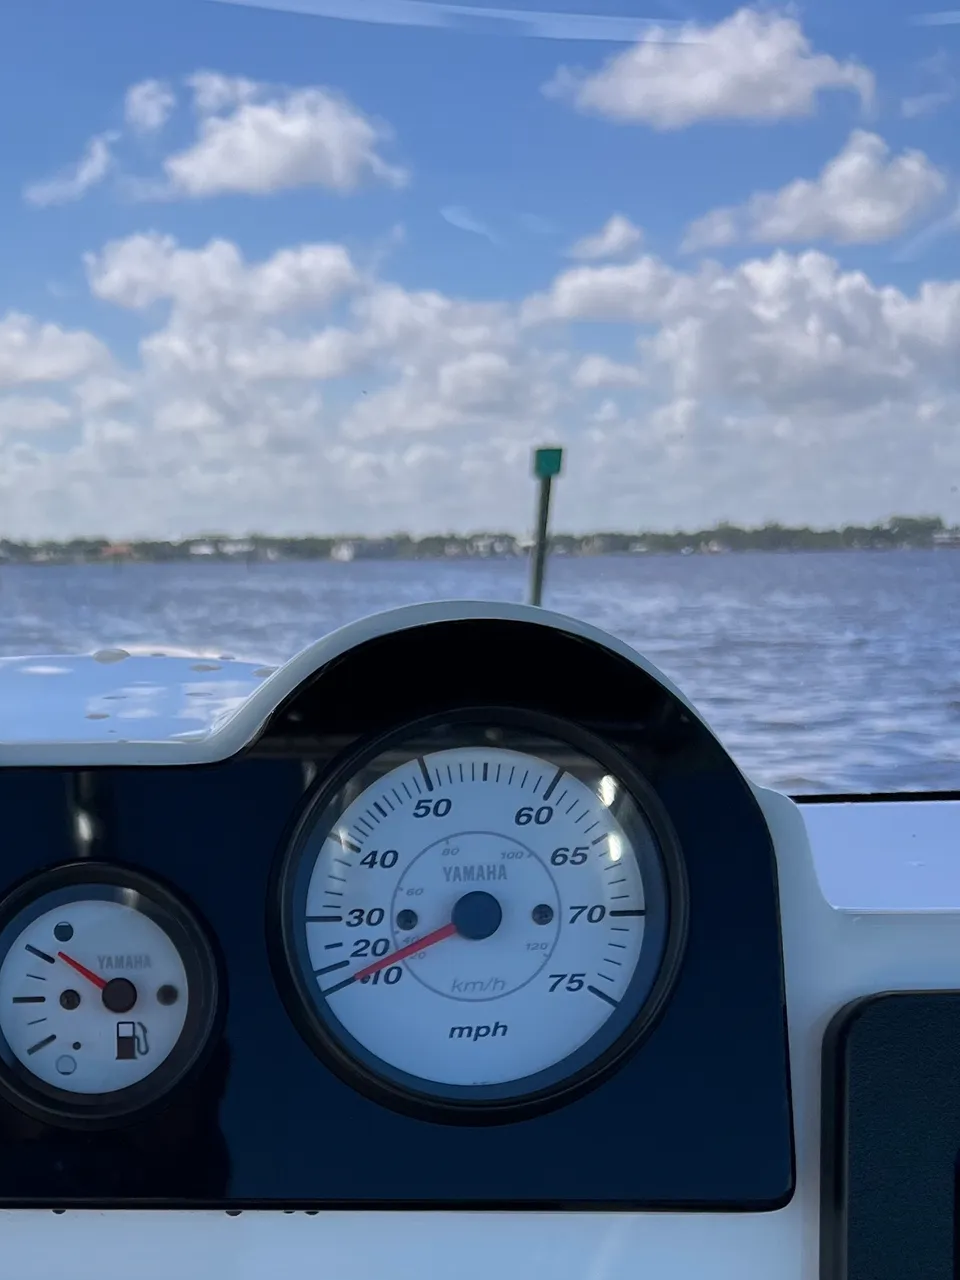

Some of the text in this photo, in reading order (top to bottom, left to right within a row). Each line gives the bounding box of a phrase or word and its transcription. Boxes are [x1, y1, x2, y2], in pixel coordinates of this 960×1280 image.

[413, 798, 452, 818] 50
[514, 806, 553, 826] 60
[360, 850, 398, 869] 40
[442, 847, 460, 856] 80
[500, 850, 524, 860] 100
[550, 846, 589, 866] 65
[443, 864, 508, 883] YAMAHA
[406, 887, 424, 896] 60
[345, 907, 385, 927] 30
[568, 904, 606, 924] 70
[350, 938, 390, 958] 20
[97, 955, 152, 970] YAMAHA
[371, 966, 403, 985] 10
[451, 977, 506, 993] km/h
[548, 973, 586, 992] 75
[448, 1021, 508, 1041] mph
